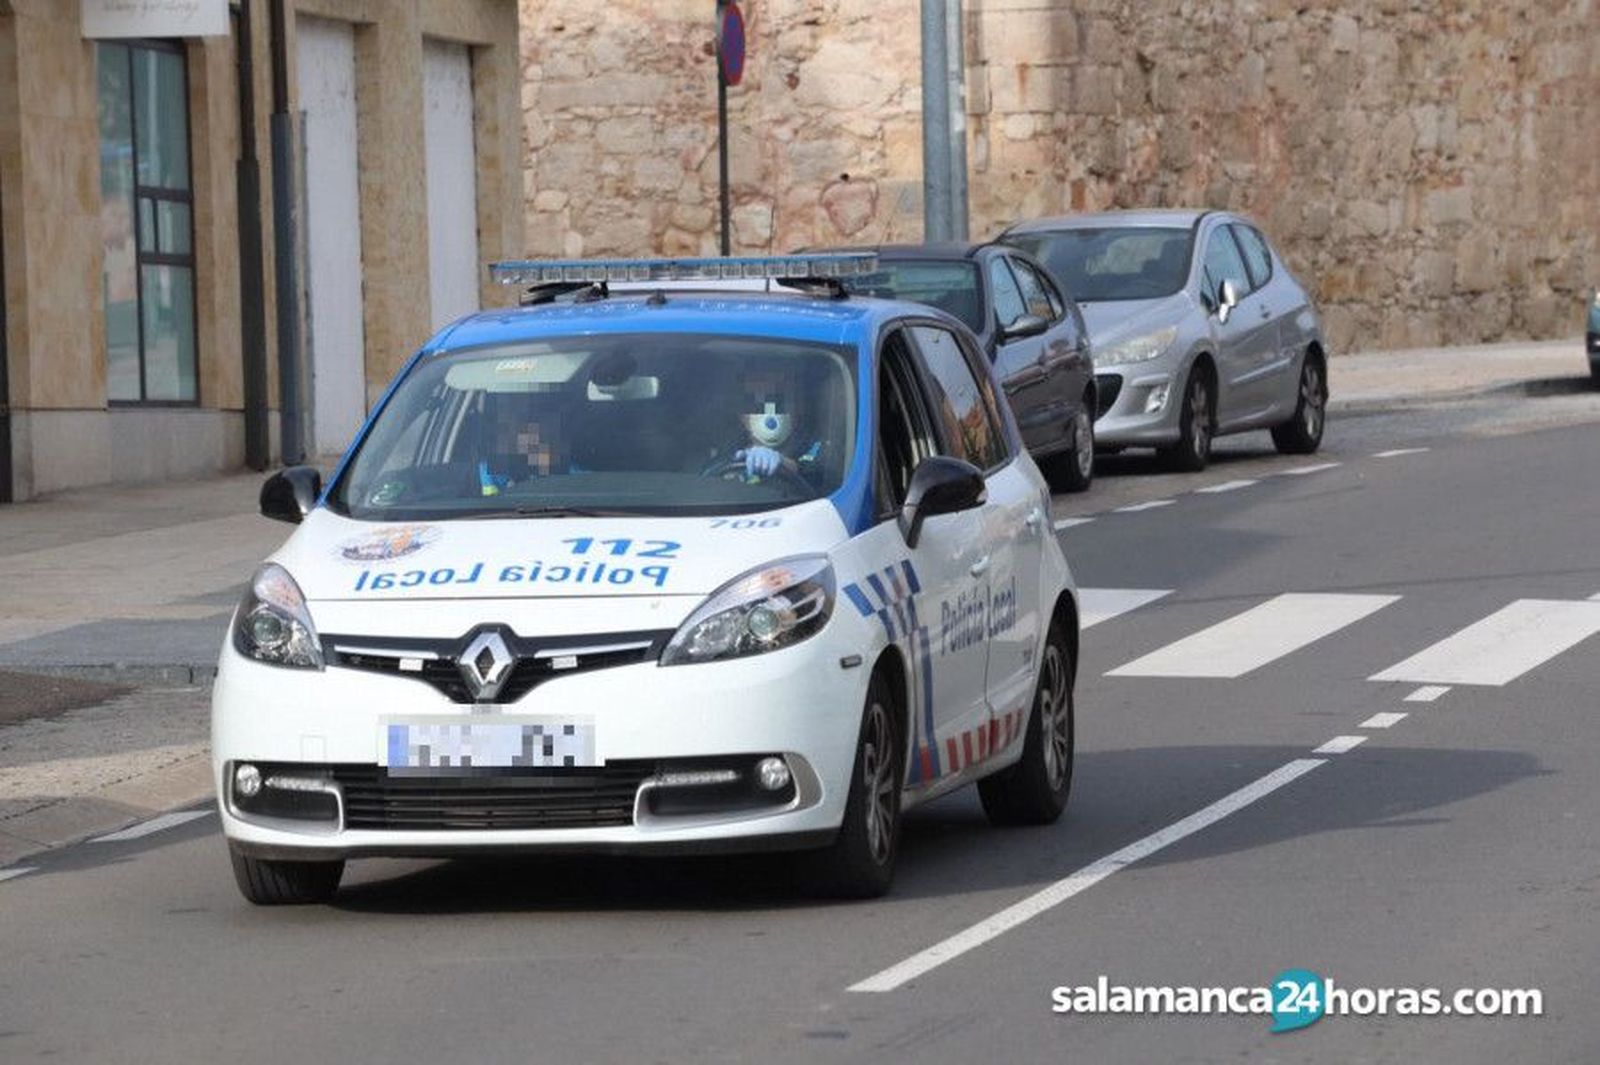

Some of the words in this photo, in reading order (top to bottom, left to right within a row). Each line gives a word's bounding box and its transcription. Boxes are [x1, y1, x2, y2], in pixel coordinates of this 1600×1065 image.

[710, 517, 782, 529] 706
[561, 537, 681, 558] 112
[986, 576, 1016, 638] Local
